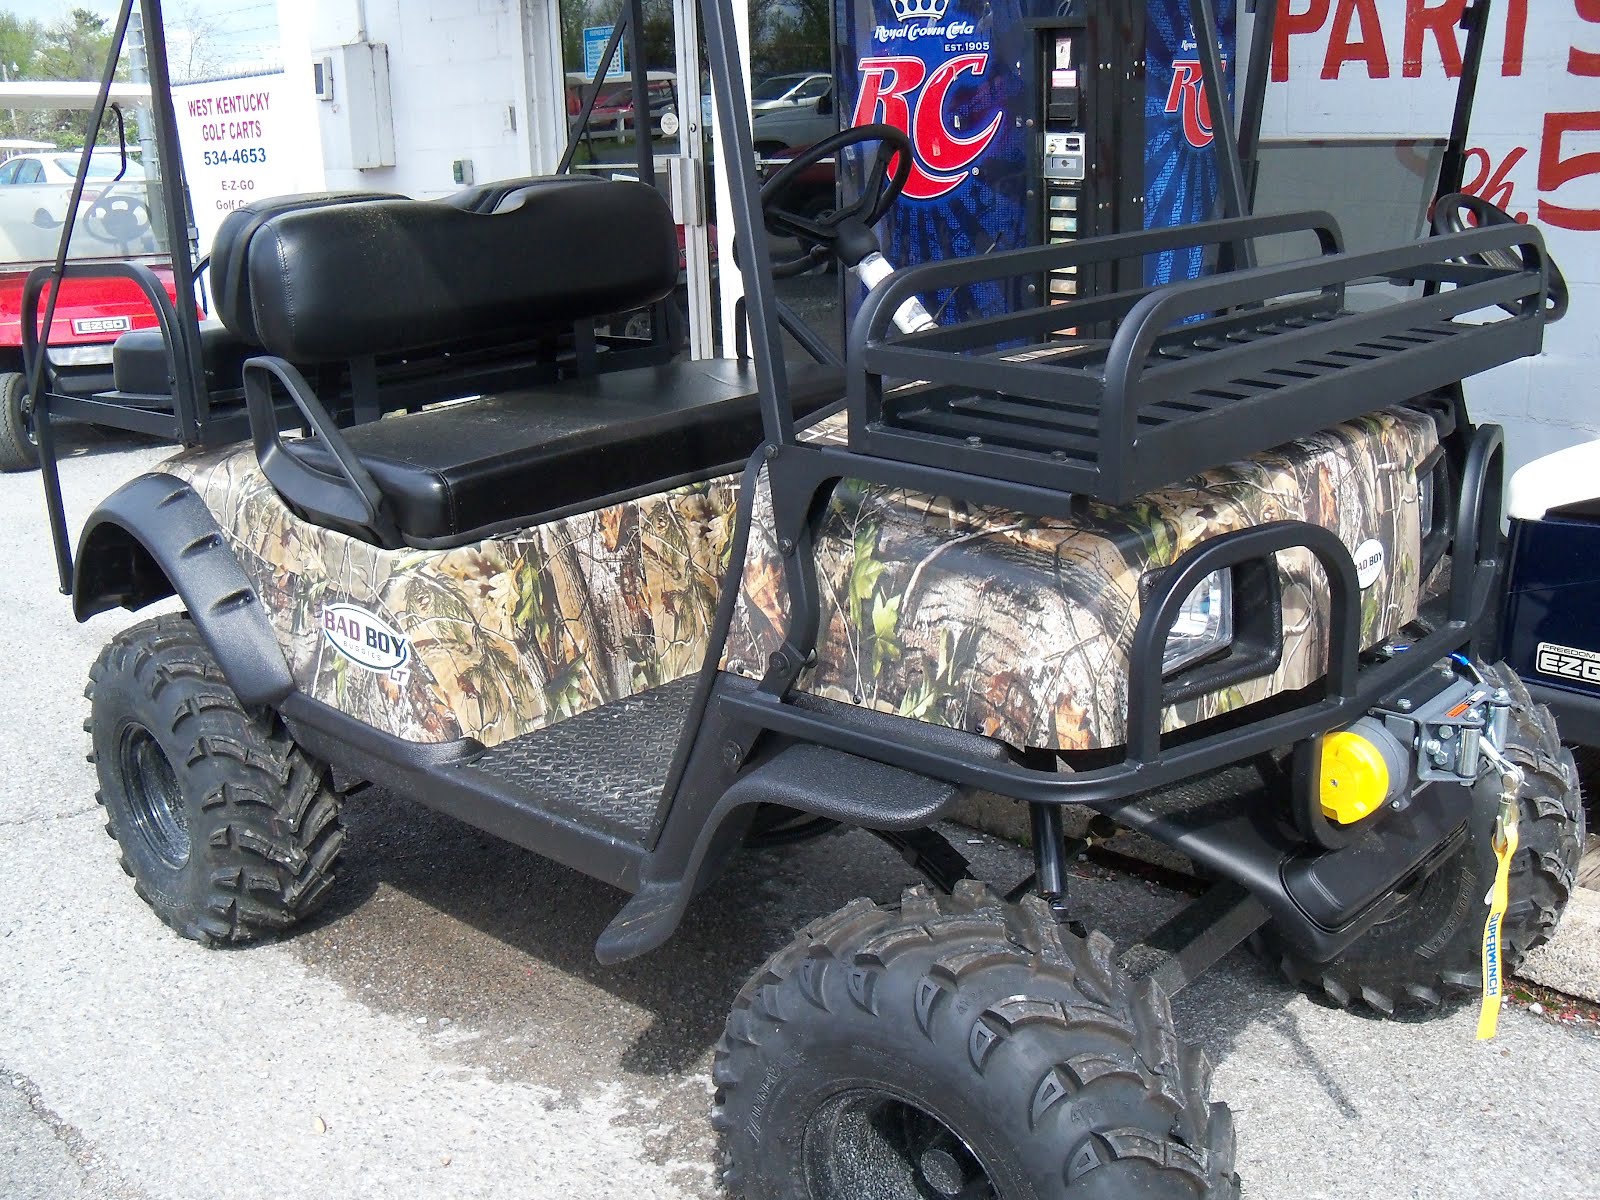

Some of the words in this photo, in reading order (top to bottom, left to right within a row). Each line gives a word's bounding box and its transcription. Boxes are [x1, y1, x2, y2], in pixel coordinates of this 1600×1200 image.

[874, 25, 909, 42] Royal
[907, 23, 946, 41] Crown
[946, 21, 975, 39] Cola
[1181, 40, 1198, 51] Roya
[188, 99, 212, 117] WEST
[216, 92, 270, 114] KENTUCKY
[202, 123, 226, 141] GOLF
[229, 119, 262, 139] CARTS
[850, 53, 1003, 198] RC
[203, 147, 267, 166] 534-4653
[221, 179, 255, 191] E-Z-GO
[216, 199, 235, 211] Golf
[1369, 552, 1382, 565] BOY
[324, 609, 361, 642] BAD
[365, 625, 406, 658] BOY
[343, 640, 382, 661] BUGGIES
[1542, 644, 1596, 659] FREEDOM
[389, 668, 407, 682] LT
[1486, 912, 1500, 996] SUPERWINCH
